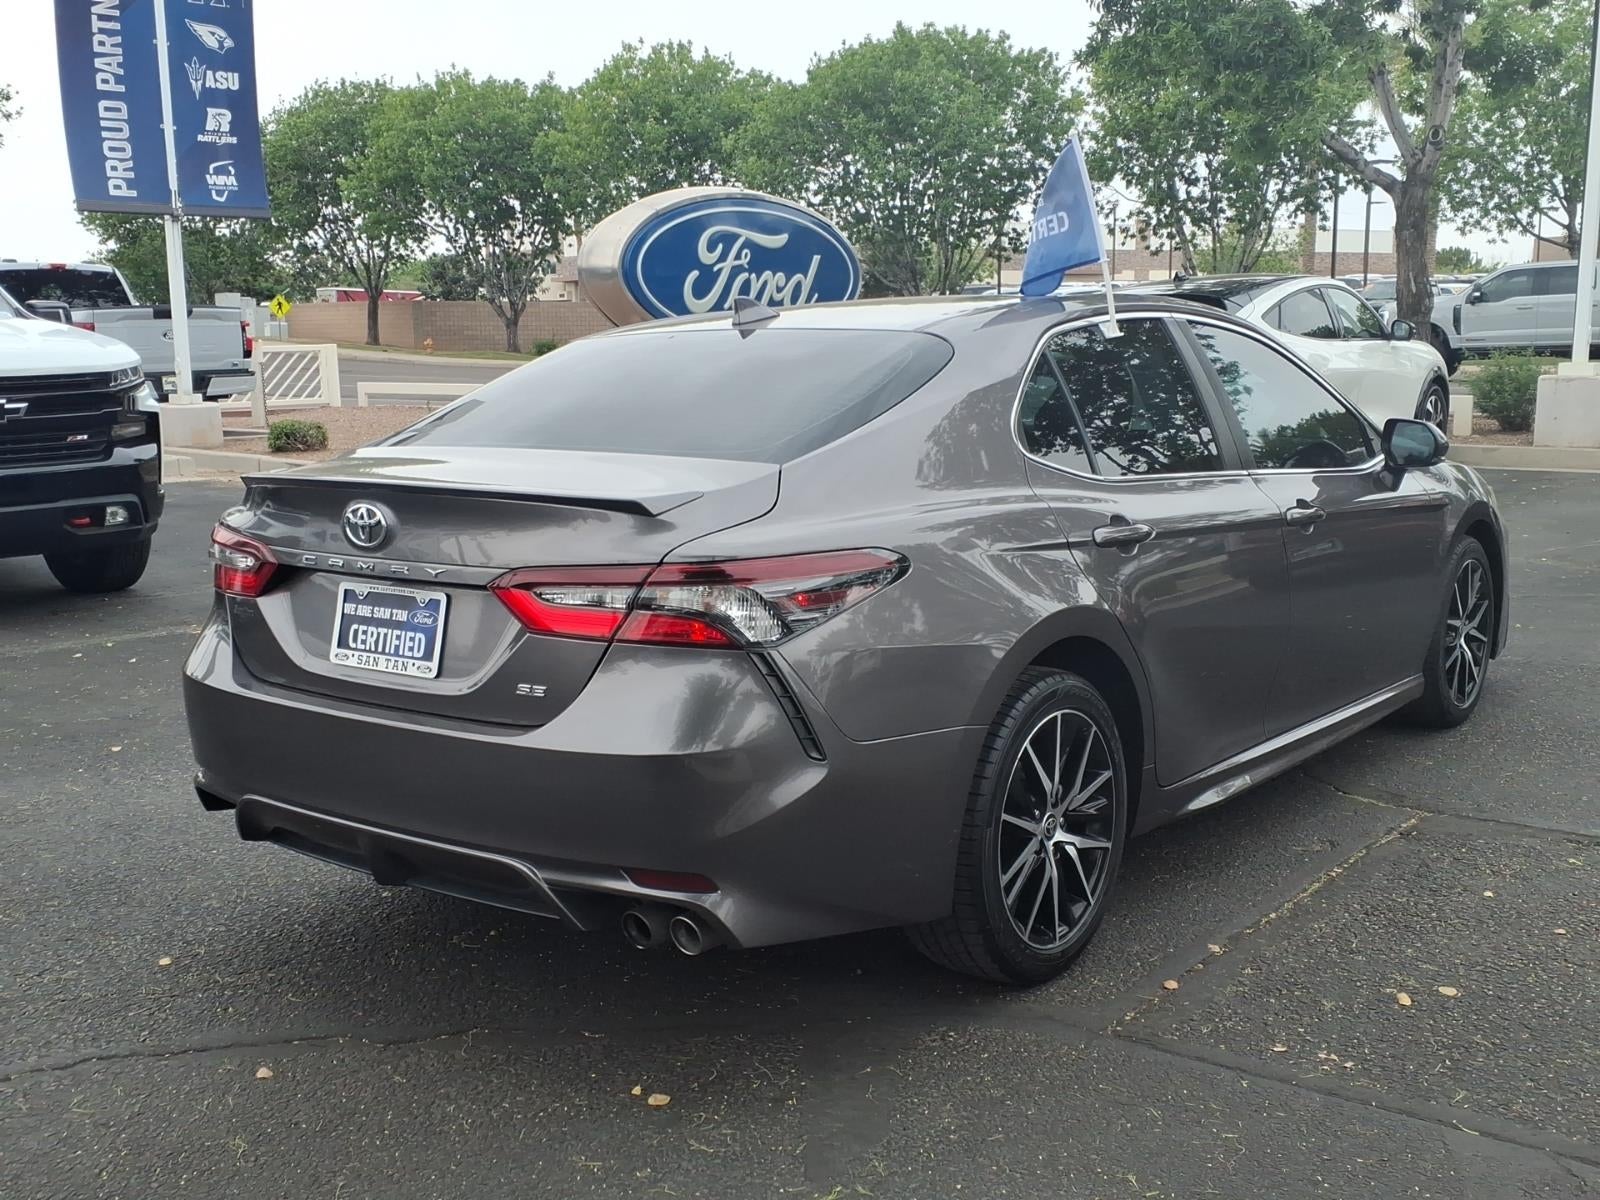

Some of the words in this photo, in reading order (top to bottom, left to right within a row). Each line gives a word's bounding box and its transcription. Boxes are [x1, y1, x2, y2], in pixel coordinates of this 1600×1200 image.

[205, 70, 240, 91] ASU
[98, 99, 138, 198] PROUD
[683, 225, 821, 314] Ford
[302, 554, 448, 579] CAMRY
[343, 602, 356, 615] WE
[356, 605, 372, 618] ARE
[372, 607, 391, 620] SAN
[392, 609, 408, 623] TAN
[413, 612, 434, 625] Ford
[348, 623, 426, 658] CERTIFIED
[356, 654, 379, 668] SAN
[385, 659, 409, 673] TAN
[515, 683, 548, 698] SE
